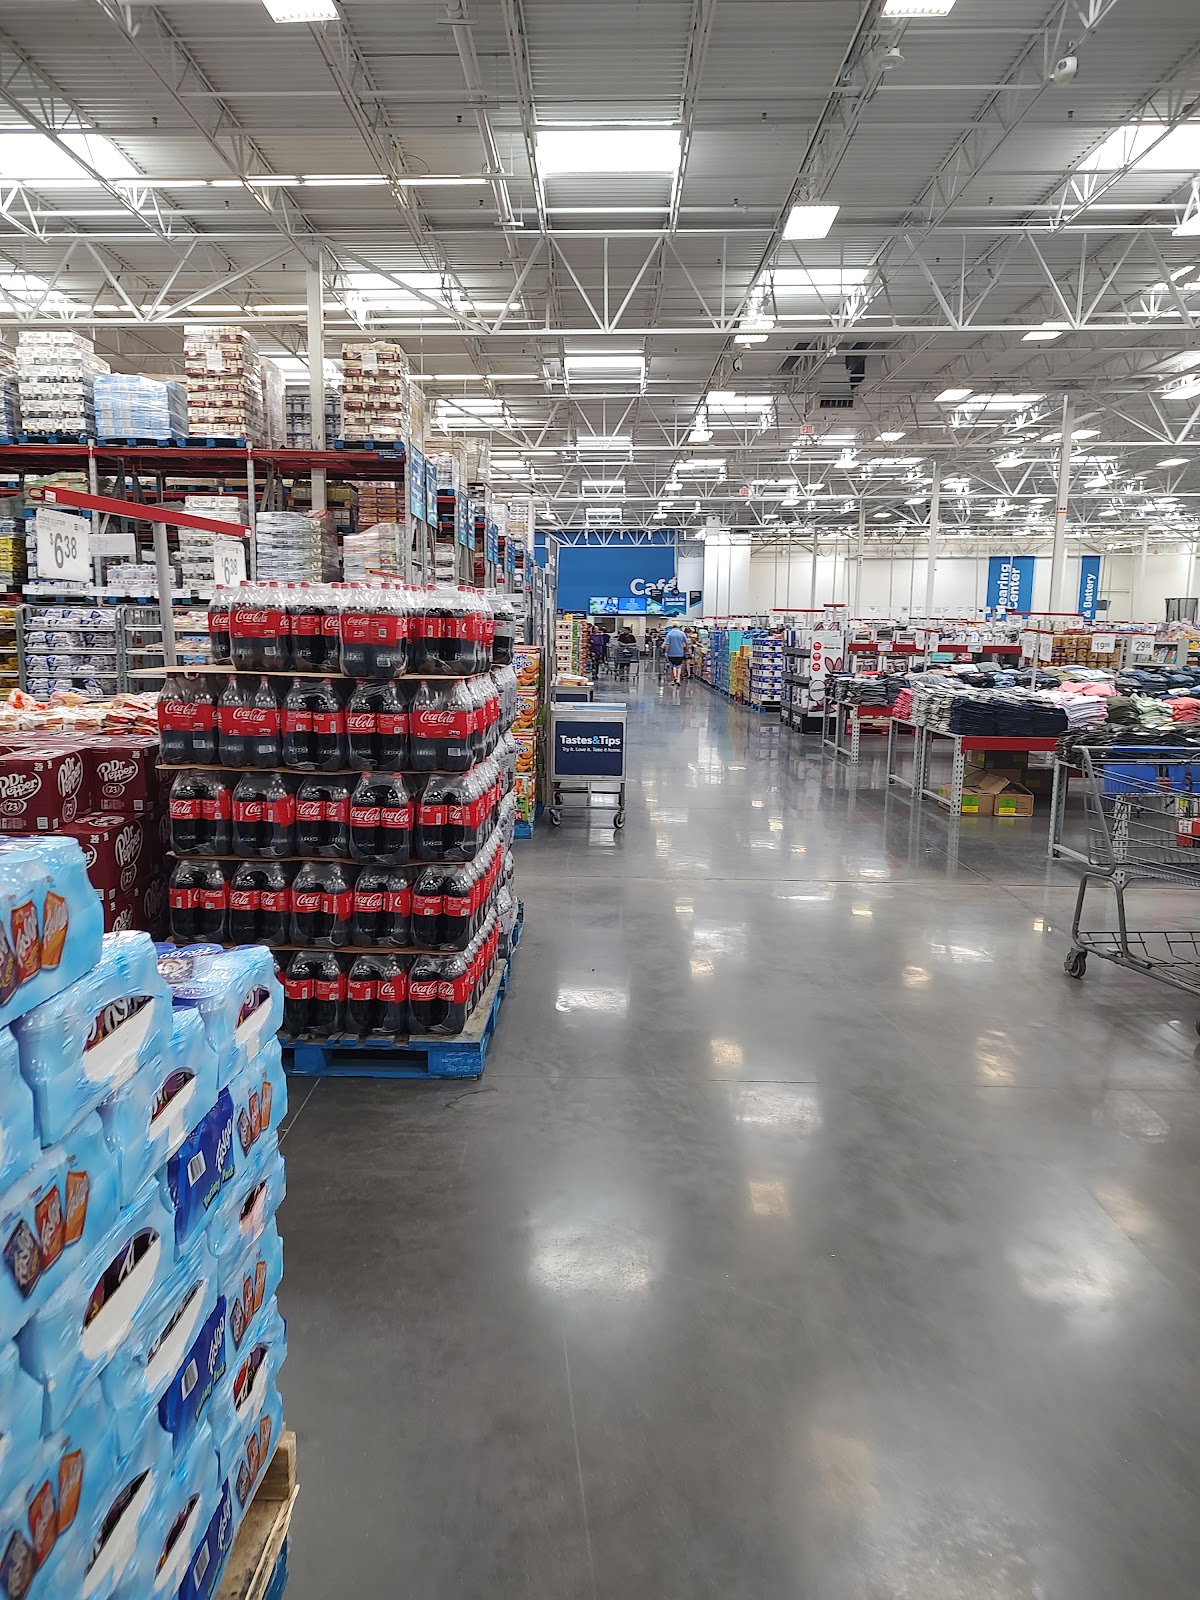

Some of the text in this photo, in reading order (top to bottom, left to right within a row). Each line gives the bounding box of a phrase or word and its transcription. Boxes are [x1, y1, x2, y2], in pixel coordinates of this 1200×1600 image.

[1009, 567, 1021, 610] Center
[1083, 573, 1097, 608] Battery
[65, 757, 75, 776] Dr
[96, 762, 136, 782] Pepper
[111, 759, 126, 772] Dr
[8, 773, 27, 787] Dr
[108, 785, 119, 794] 23
[7, 802, 19, 812] 23
[123, 825, 135, 845] Dr
